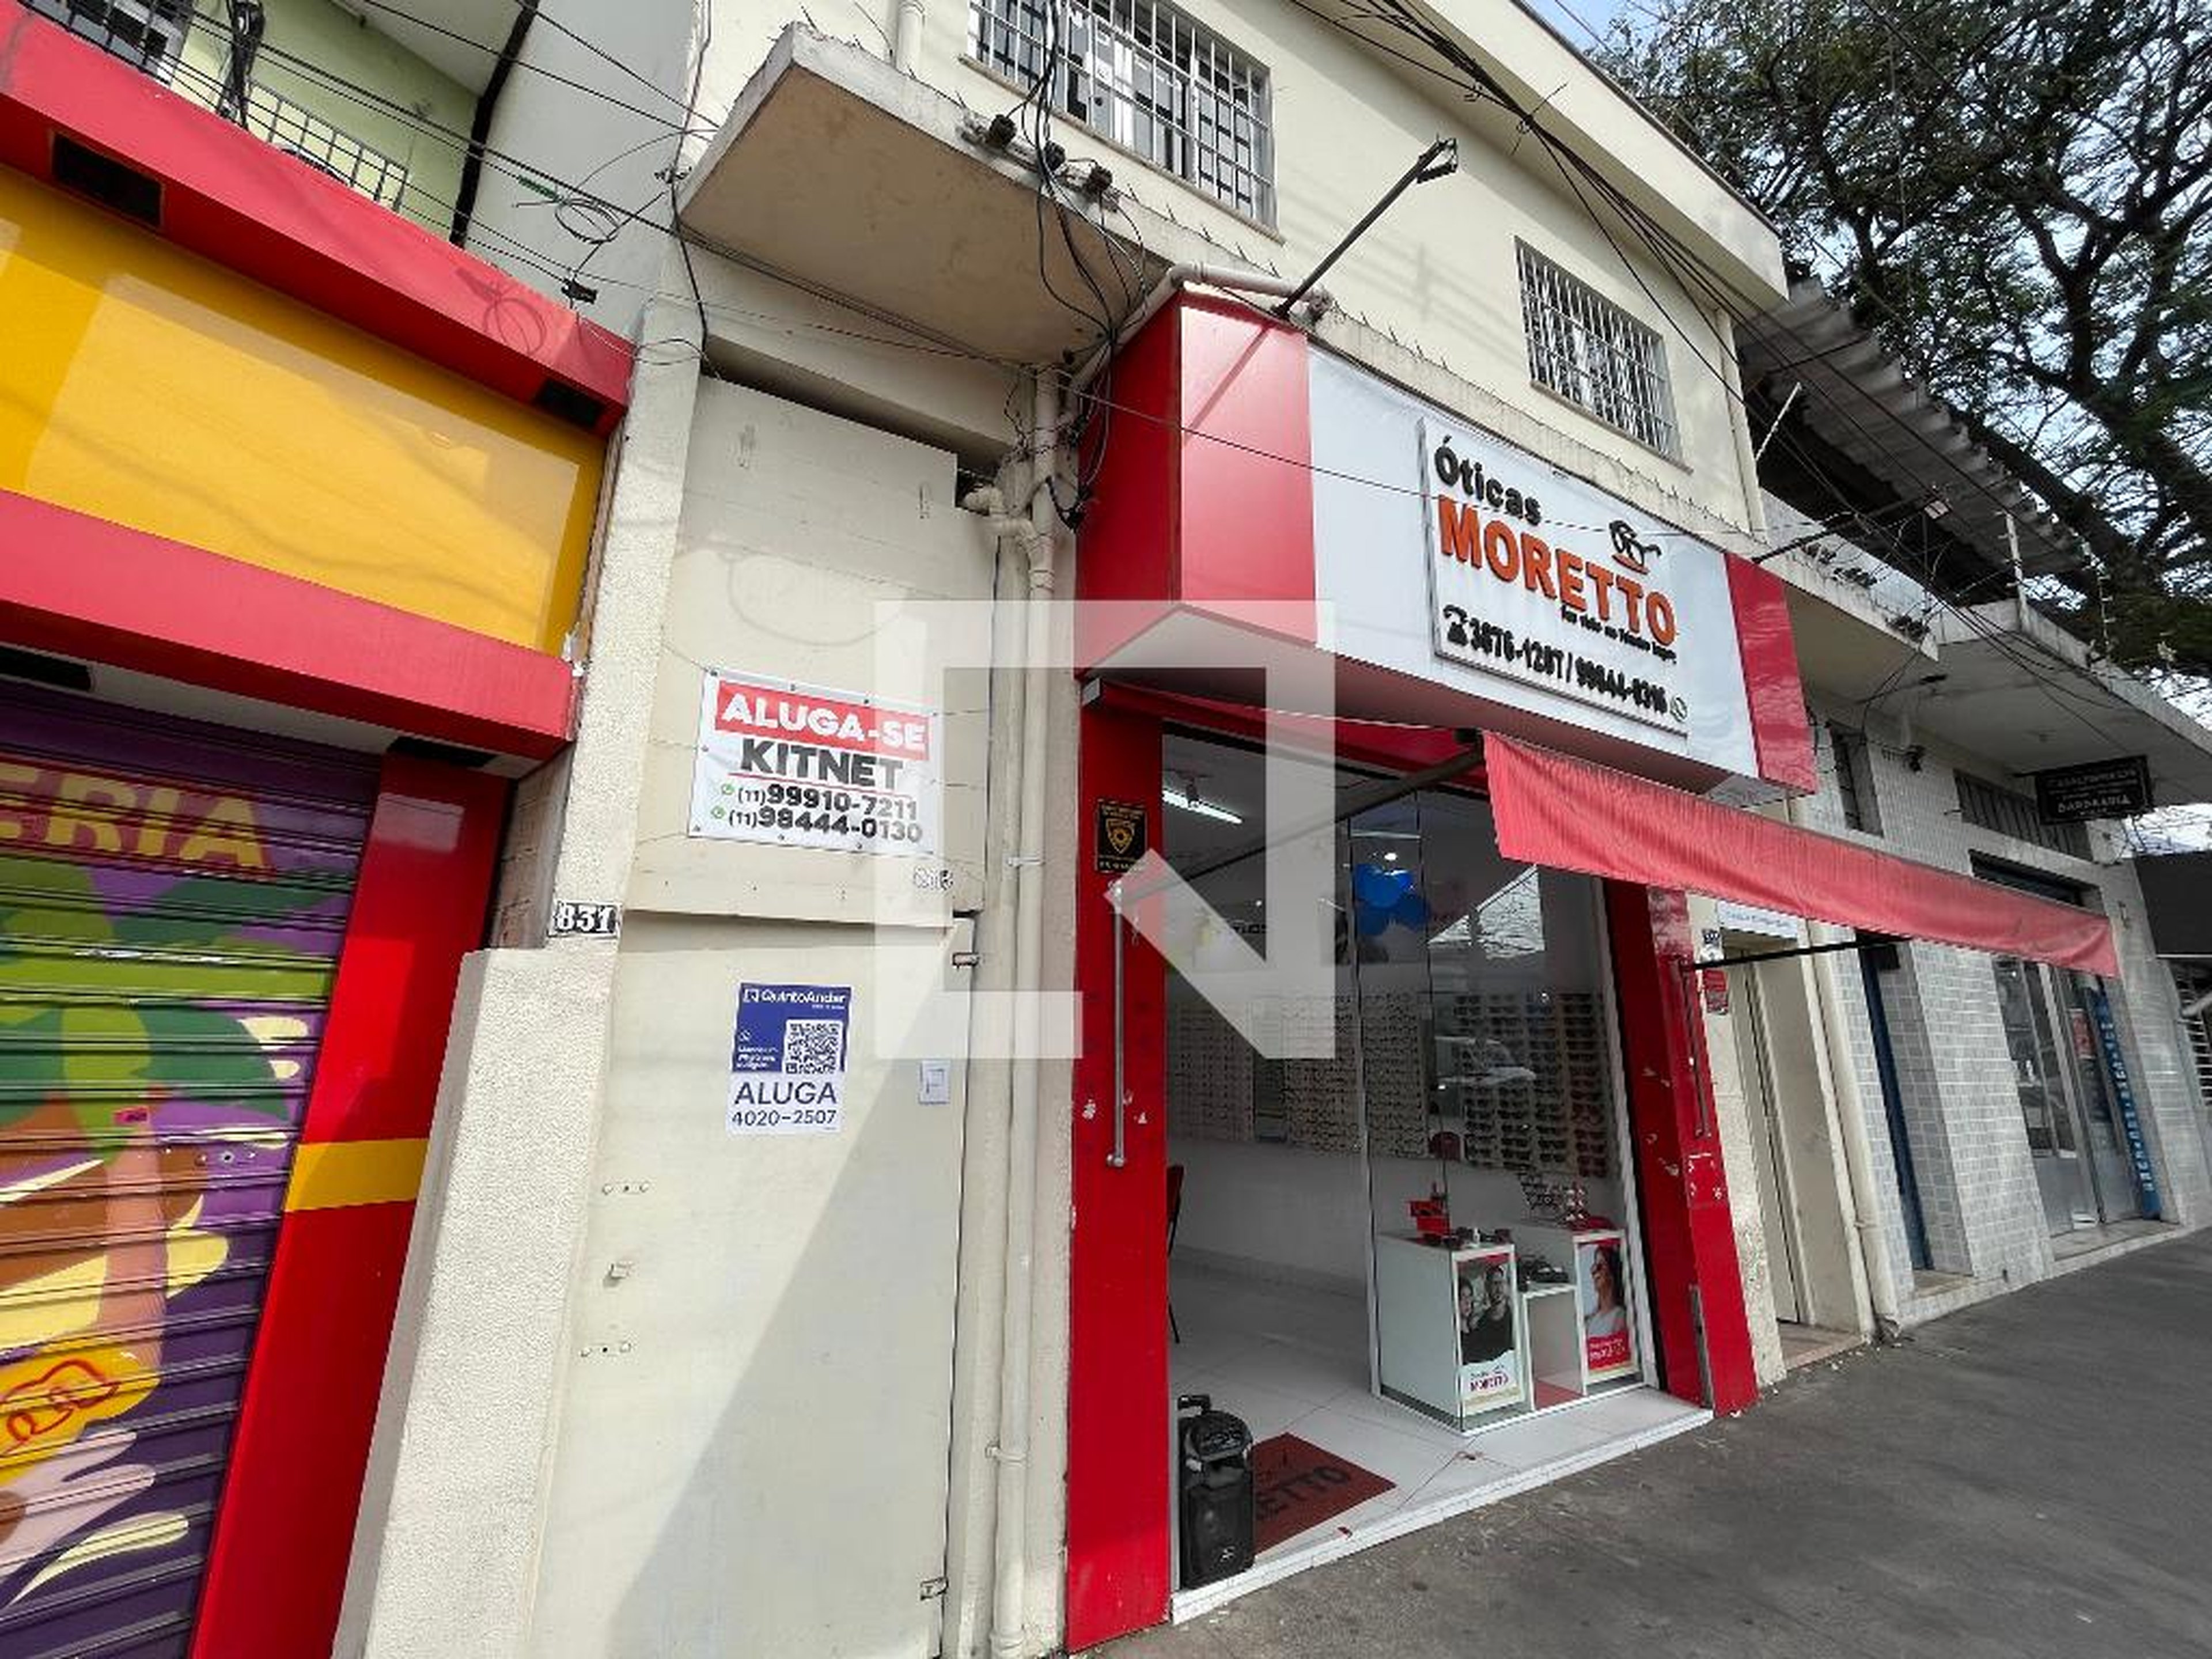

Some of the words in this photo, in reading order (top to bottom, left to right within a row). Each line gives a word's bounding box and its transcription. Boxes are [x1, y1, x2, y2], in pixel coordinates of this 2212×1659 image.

[1434, 435, 1541, 525] Óticas
[1438, 494, 1677, 646] MORETTO
[721, 693, 927, 748] ALUGA-SE
[740, 738, 903, 789] KITNET
[731, 1109, 837, 1127] 4020-2507
[734, 1081, 837, 1105] ALUGA
